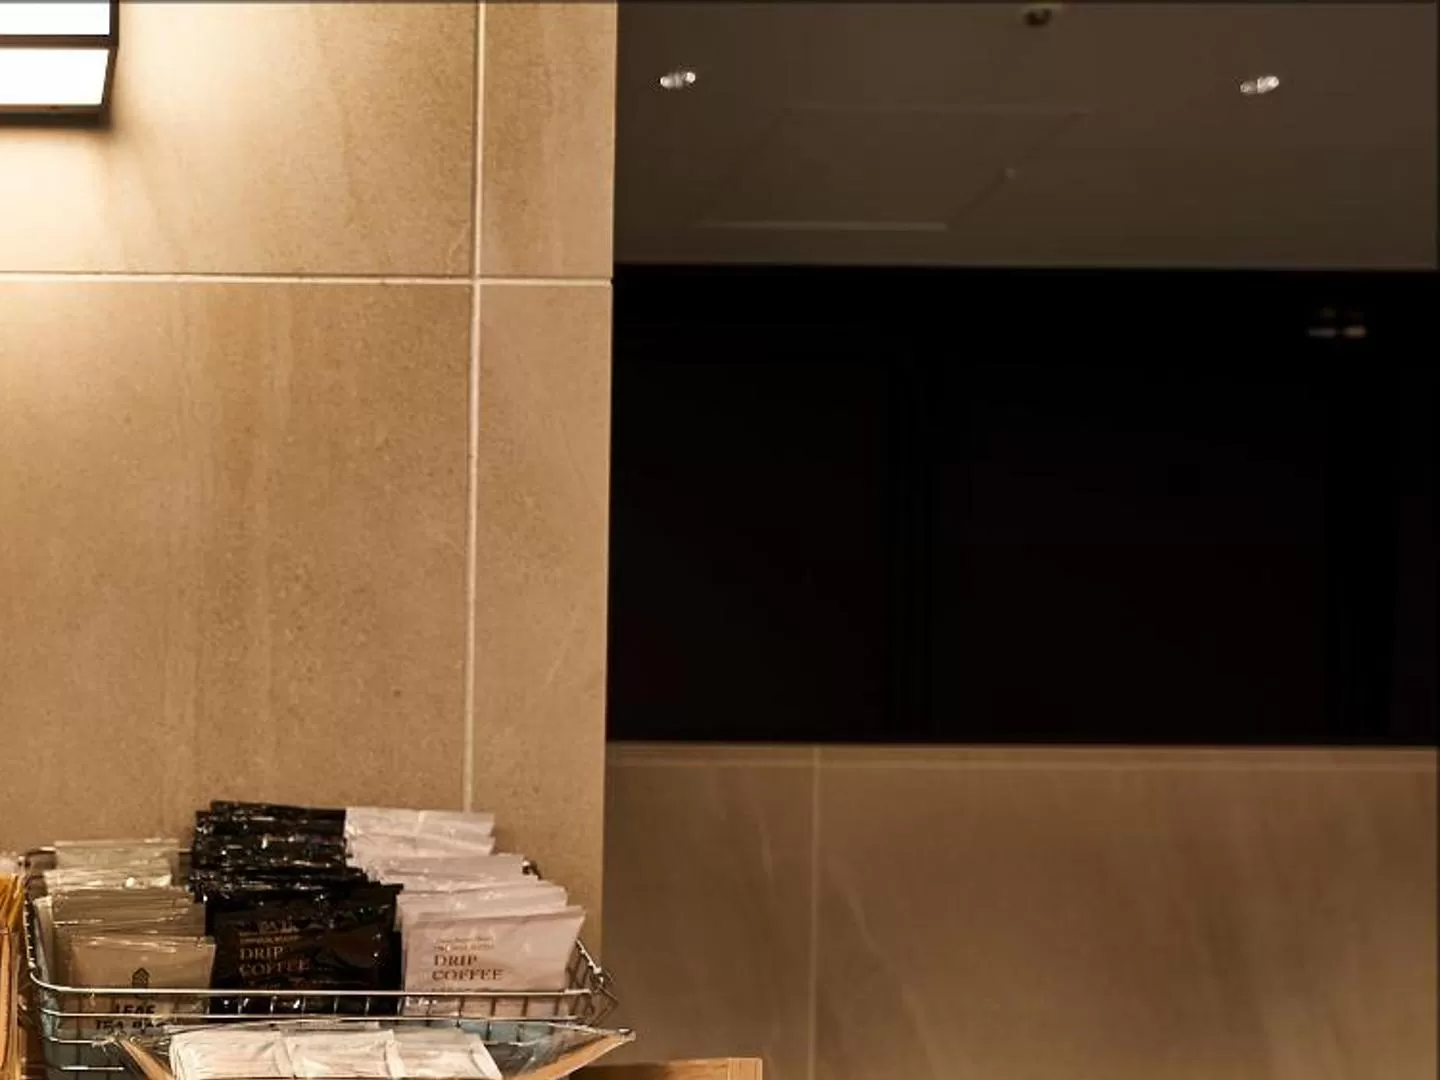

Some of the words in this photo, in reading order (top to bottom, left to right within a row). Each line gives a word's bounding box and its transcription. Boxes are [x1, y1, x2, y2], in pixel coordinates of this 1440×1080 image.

[239, 946, 284, 961] DRIP
[433, 954, 478, 967] DRIP
[238, 958, 312, 977] COFFEE
[431, 968, 504, 981] COFFEE
